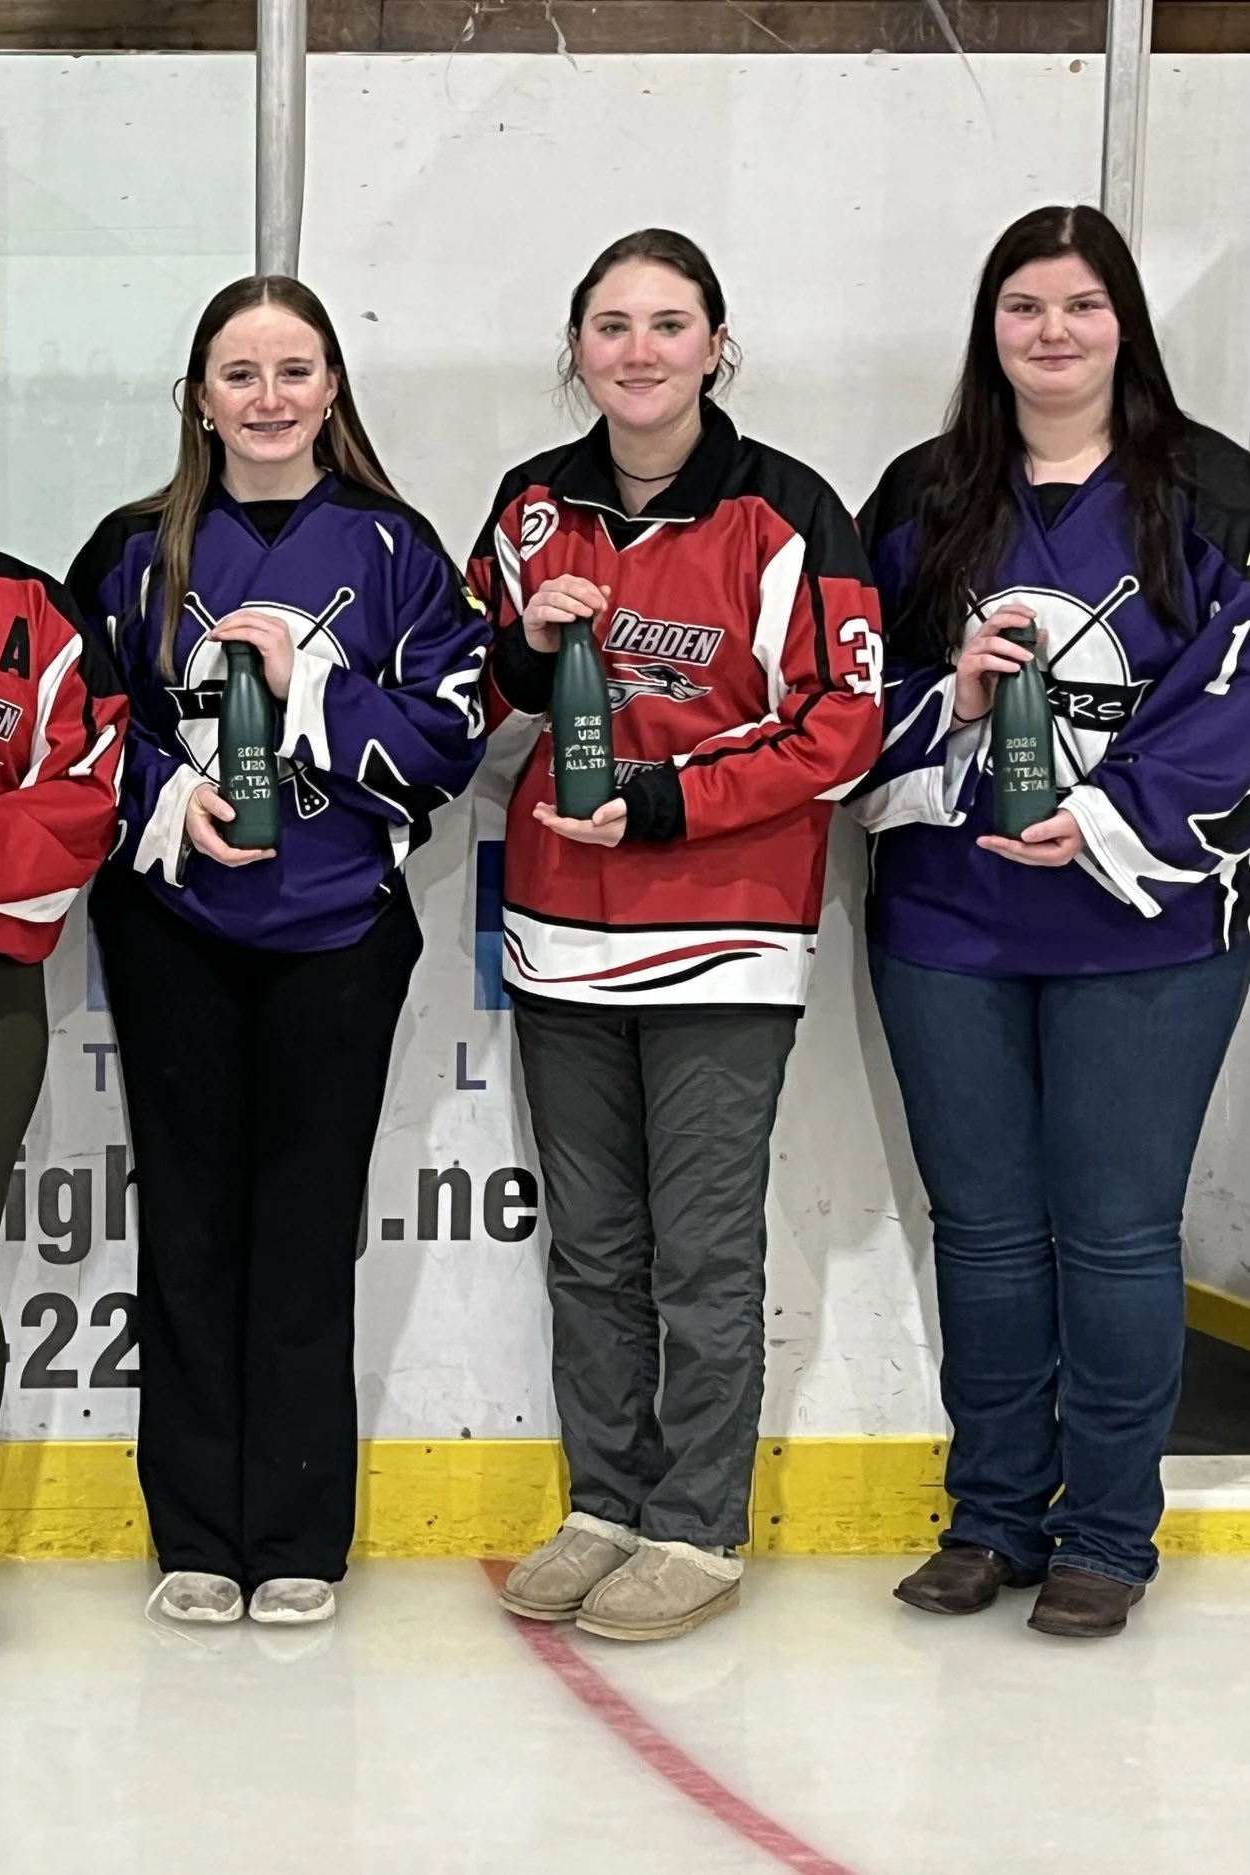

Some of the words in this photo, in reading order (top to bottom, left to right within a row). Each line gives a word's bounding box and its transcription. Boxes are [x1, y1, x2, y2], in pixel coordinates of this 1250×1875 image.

[608, 614, 717, 662] DEBDEN
[573, 715, 602, 727] 2026
[577, 729, 601, 741] U20
[1006, 737, 1037, 749] 2026
[582, 745, 605, 756] TEA
[1008, 751, 1035, 763] U20
[240, 759, 266, 771] U20
[565, 760, 588, 771] ALL
[246, 775, 270, 787] TEA
